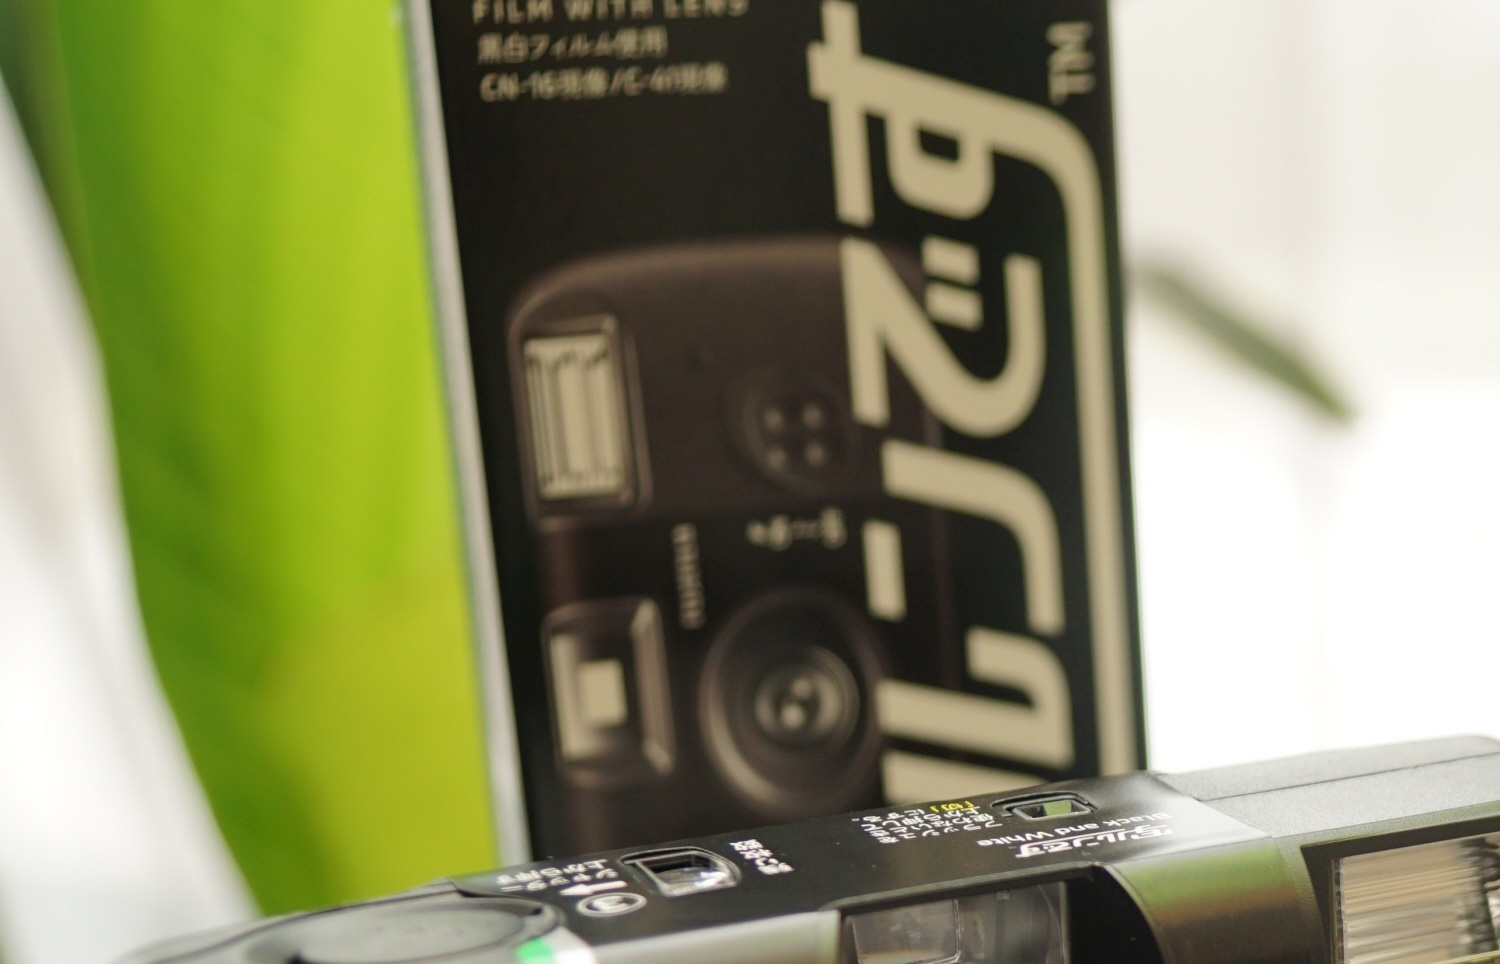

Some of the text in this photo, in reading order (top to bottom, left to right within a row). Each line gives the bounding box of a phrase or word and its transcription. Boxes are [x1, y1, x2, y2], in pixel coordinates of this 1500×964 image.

[806, 0, 1138, 806] ルンです
[977, 812, 1172, 847] Black and White
